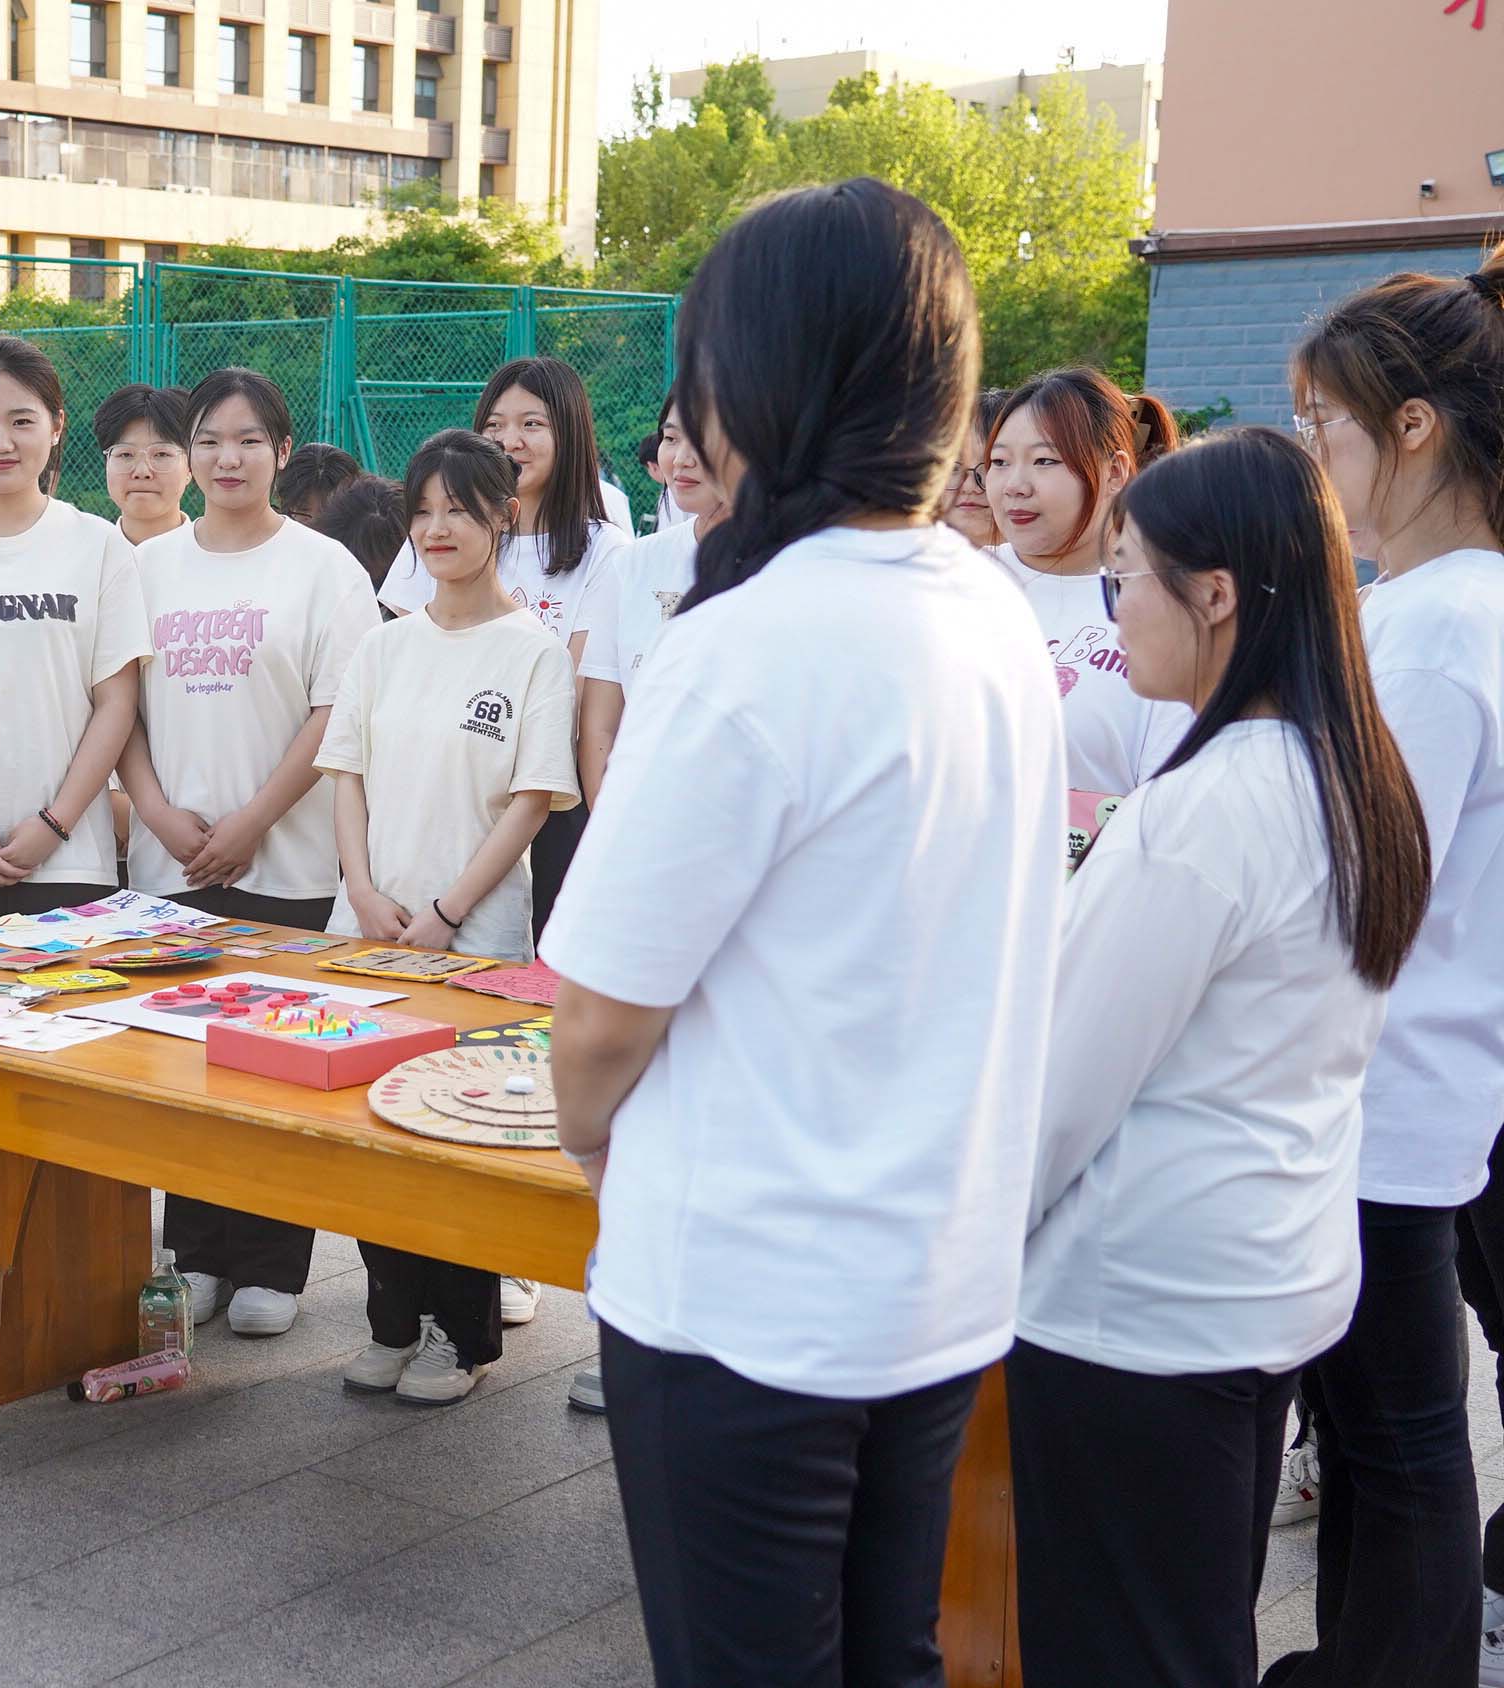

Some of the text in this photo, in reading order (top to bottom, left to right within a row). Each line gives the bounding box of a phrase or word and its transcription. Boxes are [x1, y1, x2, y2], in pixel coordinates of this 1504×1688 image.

[185, 682, 234, 695] be together
[474, 700, 502, 724] 68
